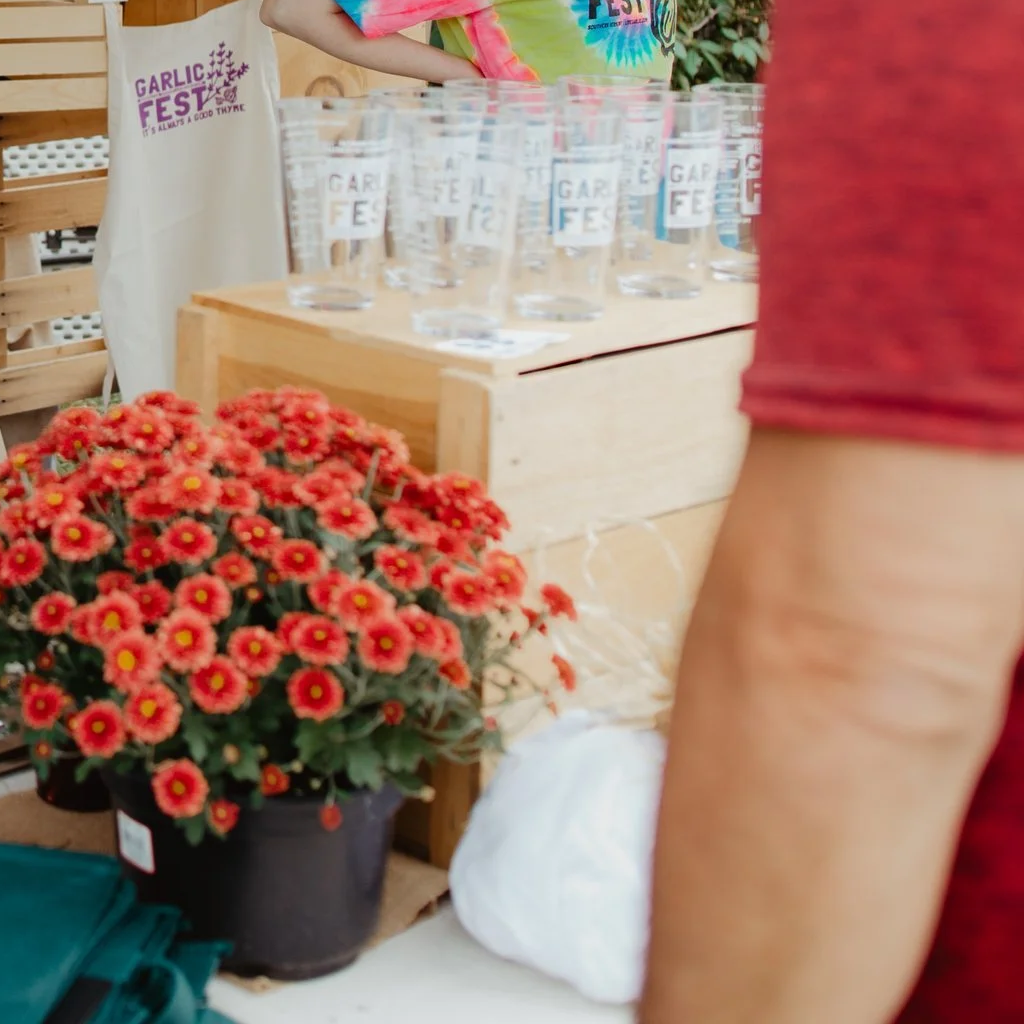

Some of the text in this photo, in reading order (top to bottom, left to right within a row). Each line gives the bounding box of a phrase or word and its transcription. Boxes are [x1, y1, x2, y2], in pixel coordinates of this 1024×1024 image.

[135, 62, 205, 98] GARLIC
[138, 84, 207, 129] FEST
[158, 117, 185, 132] ALWAYS
[194, 110, 214, 122] GOOD
[217, 103, 246, 116] THYME
